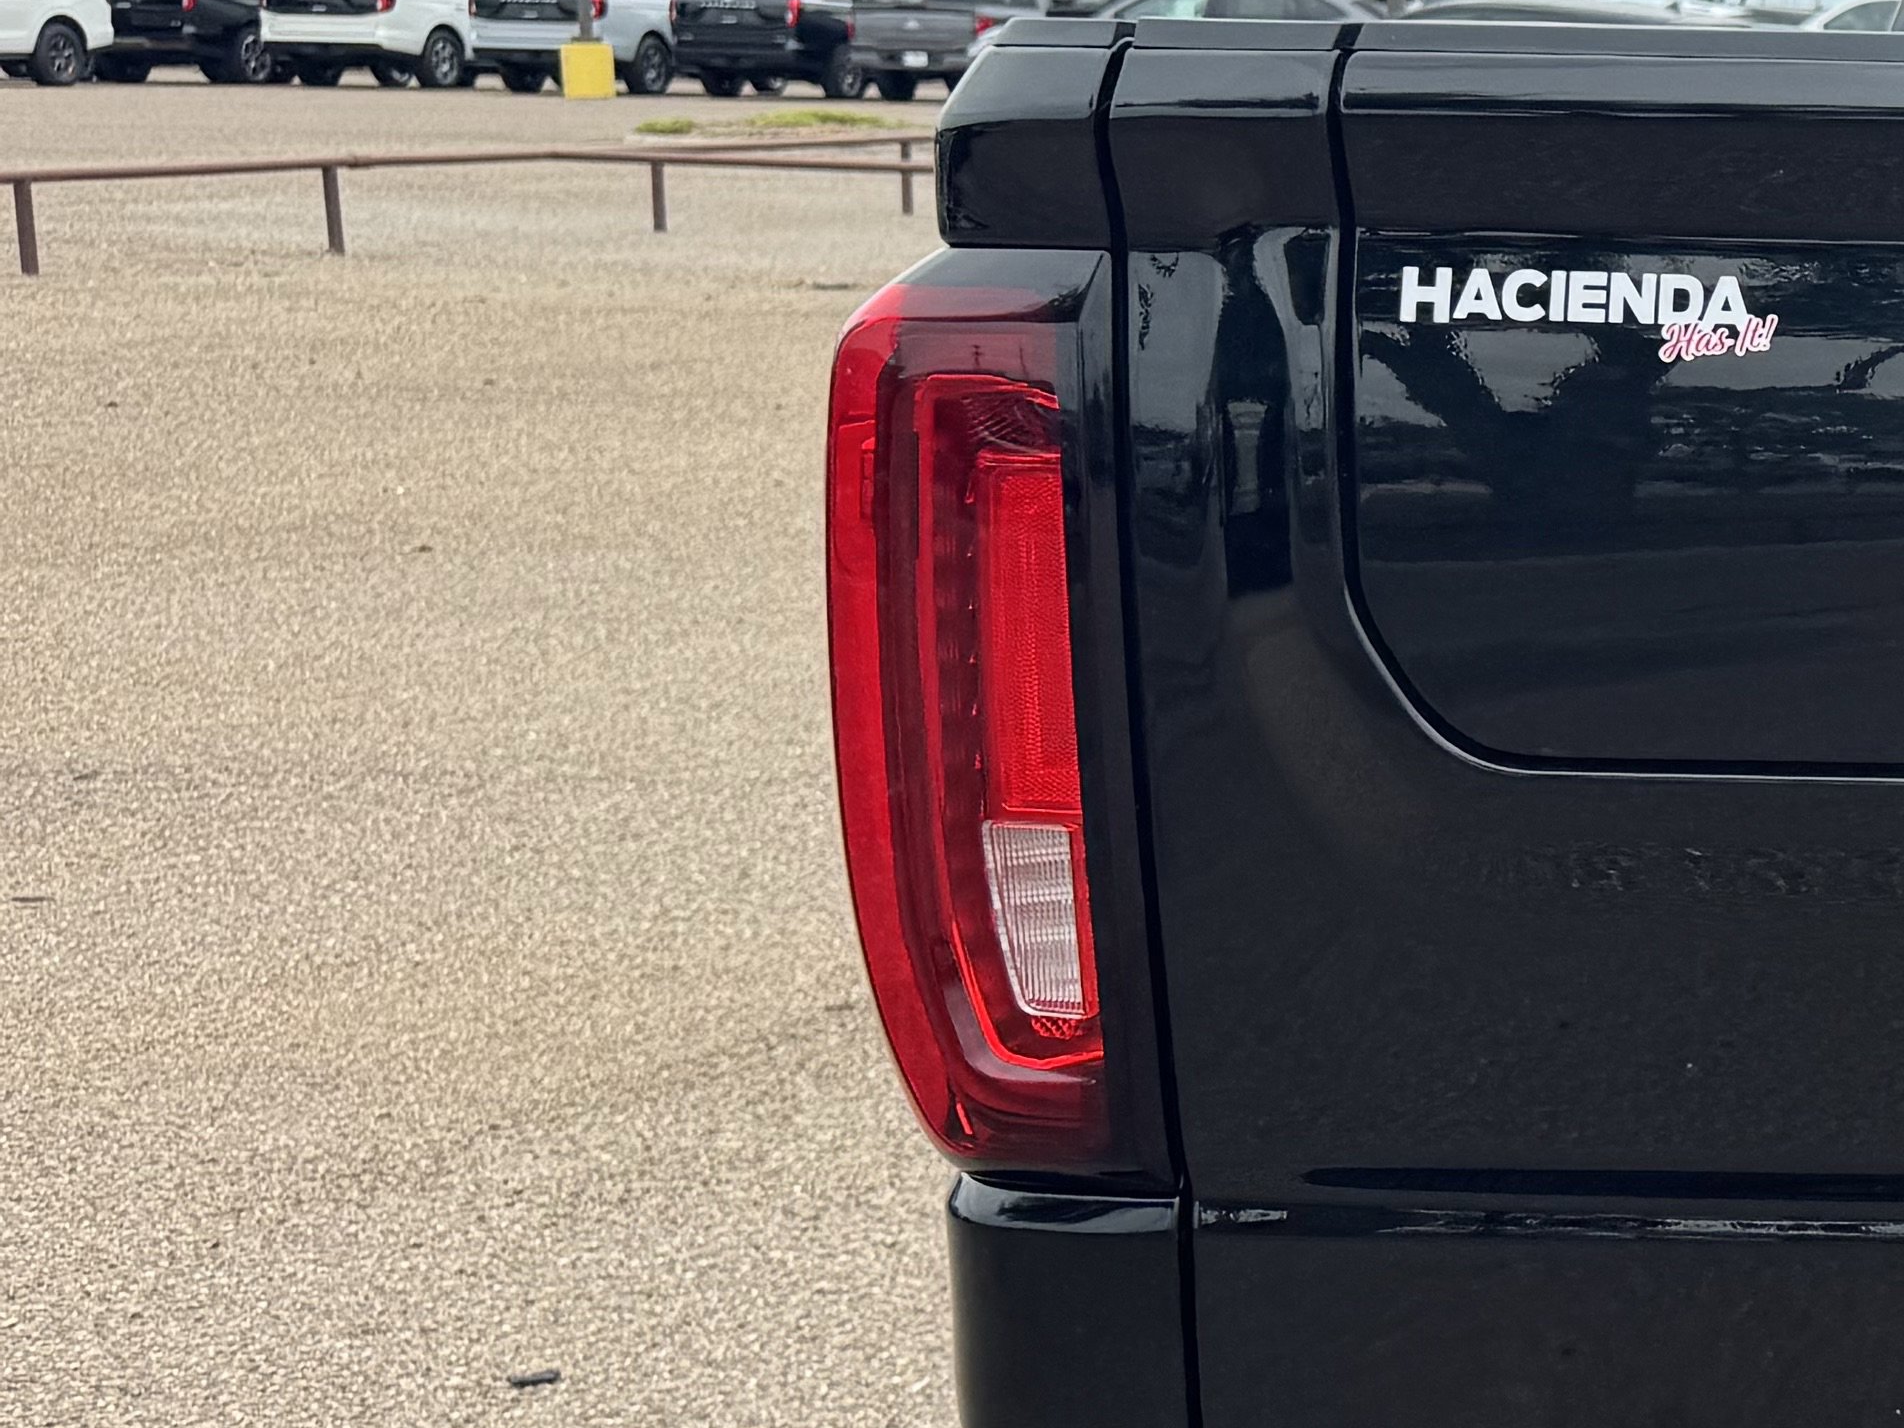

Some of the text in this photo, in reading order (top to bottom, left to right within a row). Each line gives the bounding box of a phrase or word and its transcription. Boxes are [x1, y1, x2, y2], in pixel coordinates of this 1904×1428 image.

[1399, 265, 1748, 329] HACIENDA
[1658, 314, 1779, 362] Has It!
